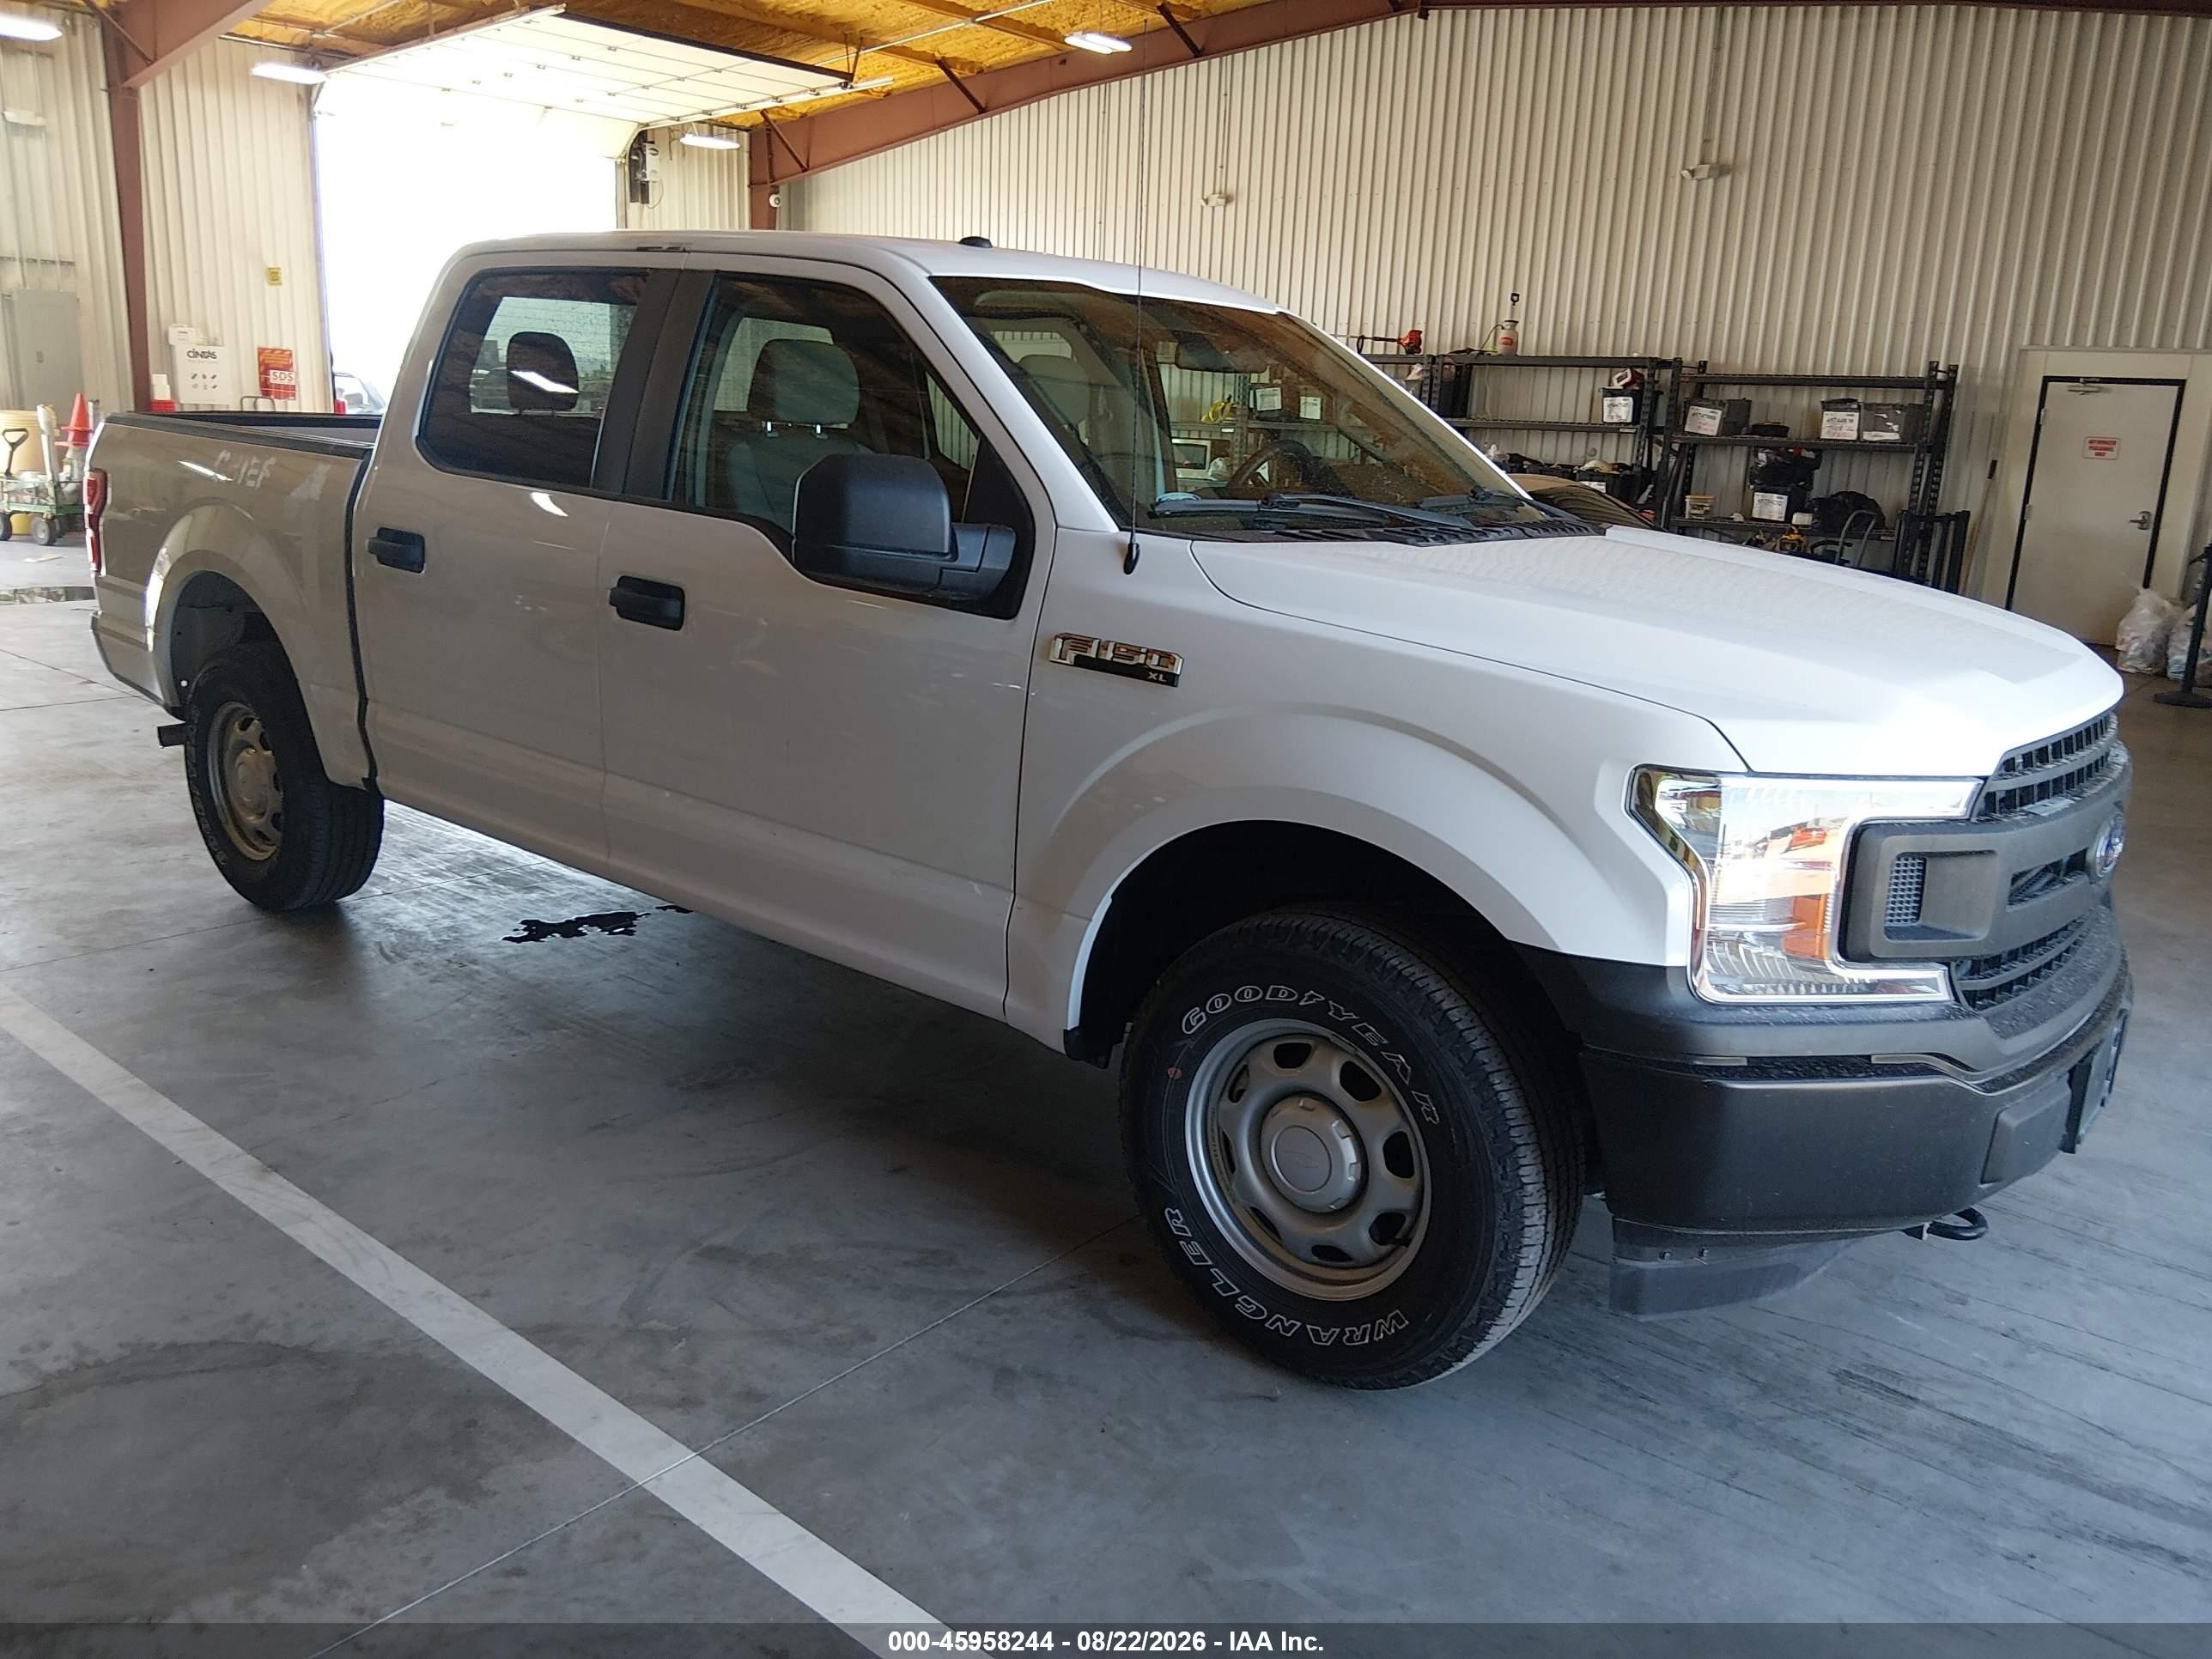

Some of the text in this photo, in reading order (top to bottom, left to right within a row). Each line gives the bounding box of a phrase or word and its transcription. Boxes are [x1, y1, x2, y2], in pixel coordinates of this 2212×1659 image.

[272, 371, 294, 381] SDS
[1146, 671, 1168, 683] XL
[1182, 984, 1441, 1126] GOODYEAR
[1164, 1206, 1410, 1346] WRANGLER
